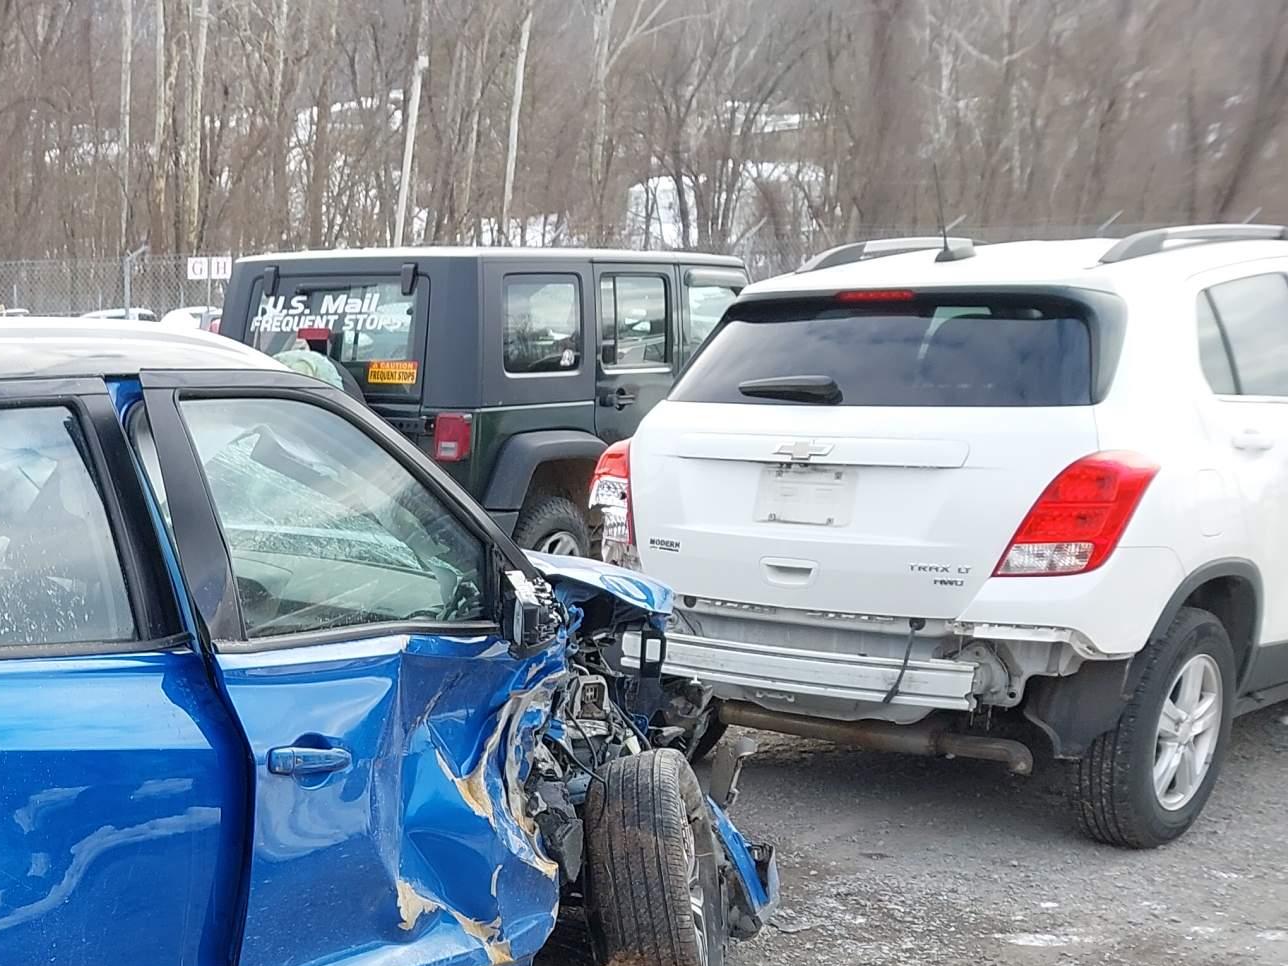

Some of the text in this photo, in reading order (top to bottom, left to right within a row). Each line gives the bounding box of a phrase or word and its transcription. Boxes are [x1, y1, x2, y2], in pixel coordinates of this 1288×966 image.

[192, 260, 204, 276] G
[268, 292, 381, 315] U.S. Mail
[250, 314, 402, 332] FREQUENT STOPS
[379, 361, 414, 369] CAUTION
[370, 370, 415, 382] FREQUENT STOPS
[649, 538, 681, 548] MODERN
[909, 563, 972, 574] TRAX LT
